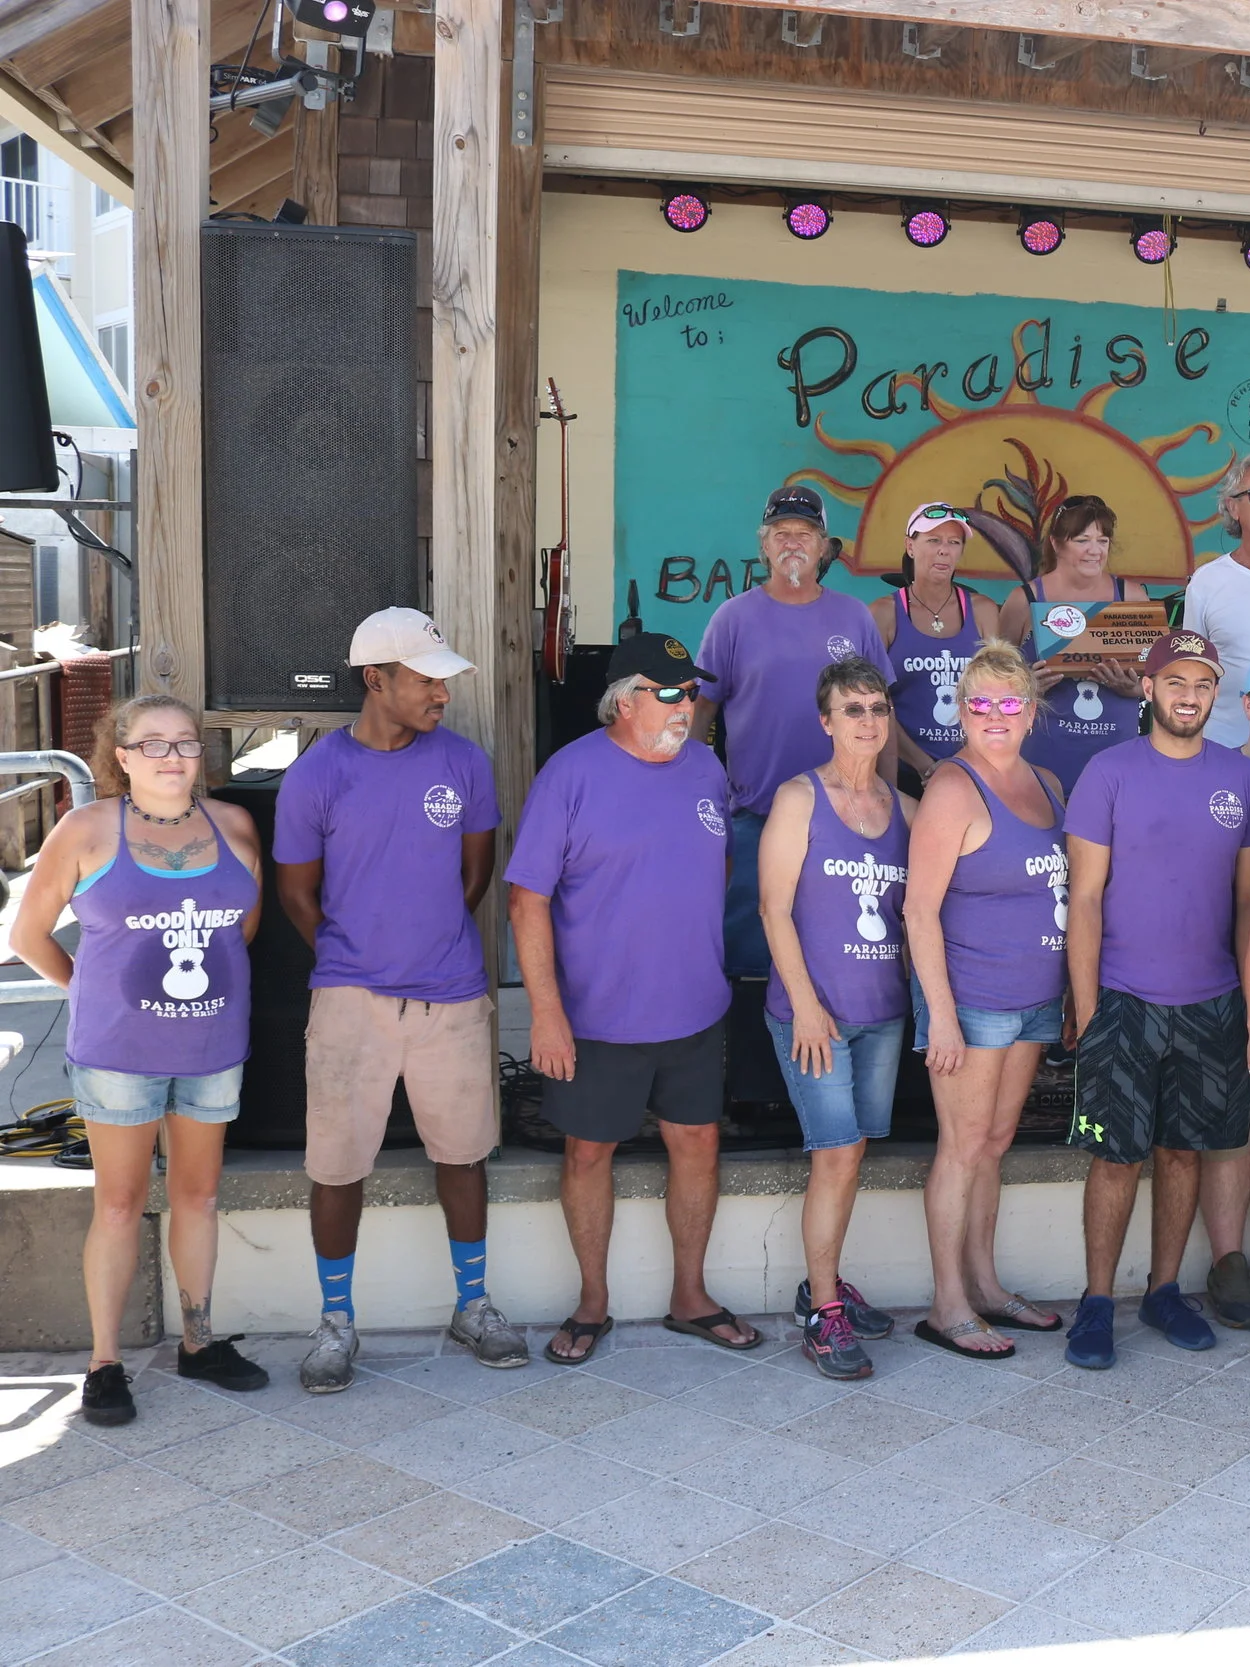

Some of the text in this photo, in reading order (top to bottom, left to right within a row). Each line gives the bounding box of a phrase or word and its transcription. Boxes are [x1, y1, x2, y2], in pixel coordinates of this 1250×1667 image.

[623, 291, 734, 328] Welcome
[777, 317, 1210, 428] Paradise
[903, 657, 944, 672] GOOD
[1062, 652, 1102, 664] 2019
[294, 675, 331, 683] QSC
[1059, 719, 1117, 731] PARADISE
[823, 858, 868, 878] GOOD
[1025, 854, 1060, 876] GOOD
[851, 877, 891, 896] ONLY
[1047, 870, 1069, 888] ONL
[125, 909, 243, 930] GOOD VIBES
[162, 929, 213, 949] ONLY
[843, 943, 900, 954] PARADISE
[140, 996, 225, 1012] PARADISE
[192, 1009, 218, 1018] GRILL
